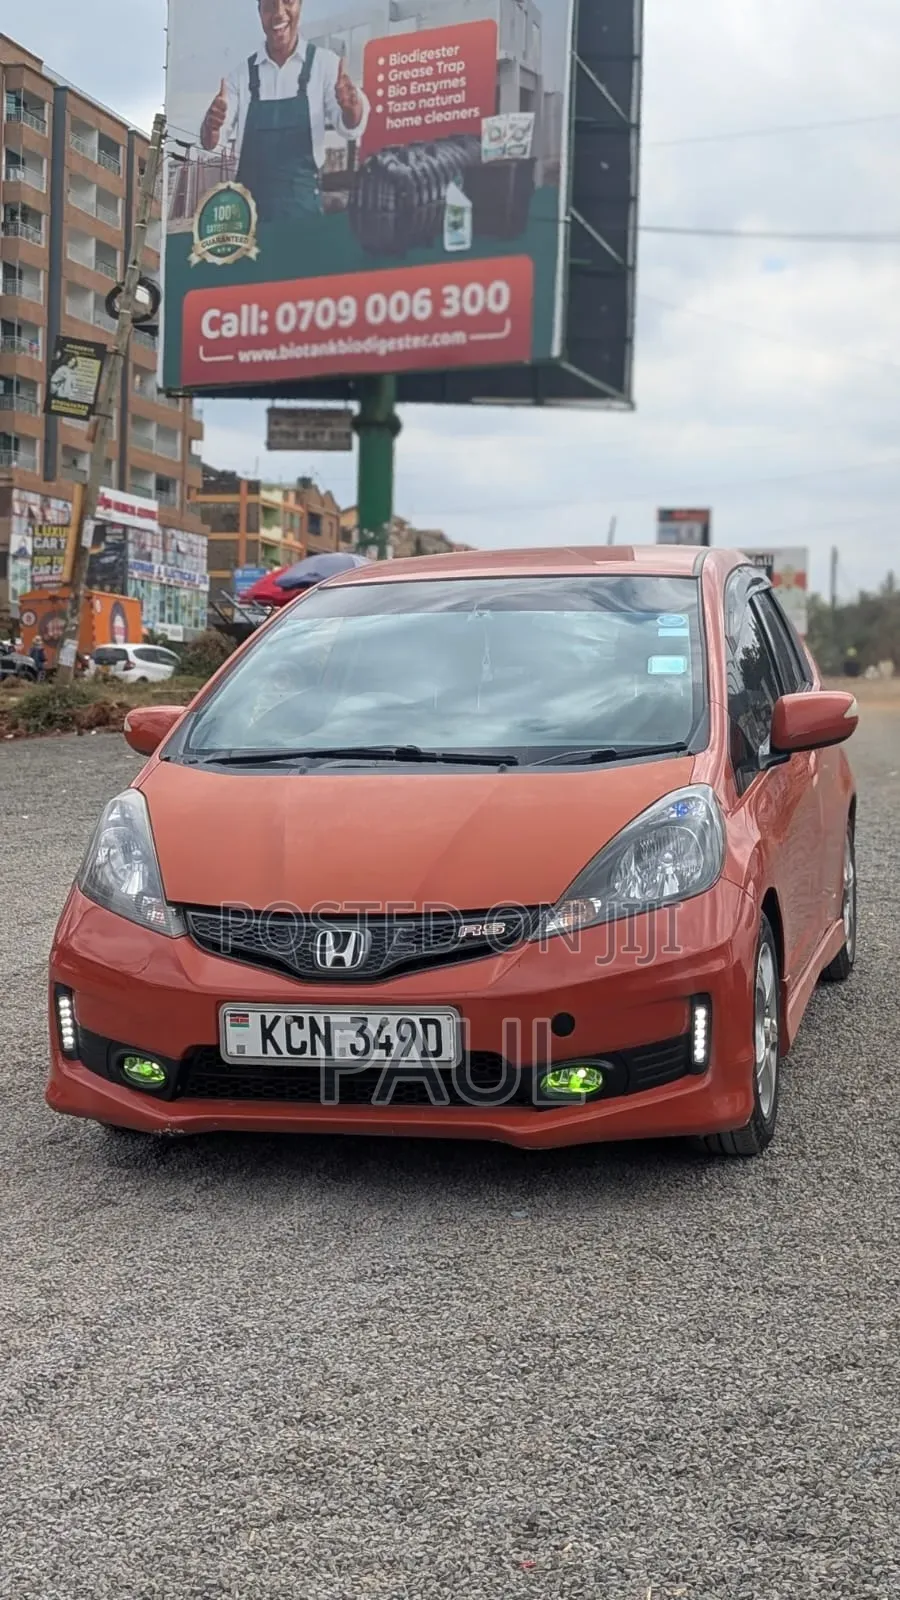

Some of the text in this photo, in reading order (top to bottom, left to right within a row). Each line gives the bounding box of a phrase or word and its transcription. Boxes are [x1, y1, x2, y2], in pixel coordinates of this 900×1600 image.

[388, 46, 460, 66] Biodigester
[388, 61, 465, 82] Grease Trap
[387, 76, 467, 98] Bio Enzymes
[386, 90, 466, 113] Tazo natural
[386, 106, 480, 130] home cleaners
[201, 280, 510, 339] Call: 0709 006 300
[238, 330, 468, 363] www.biotankbiodigester.com
[458, 922, 506, 938] RS
[260, 1014, 443, 1058] KCN 349D
